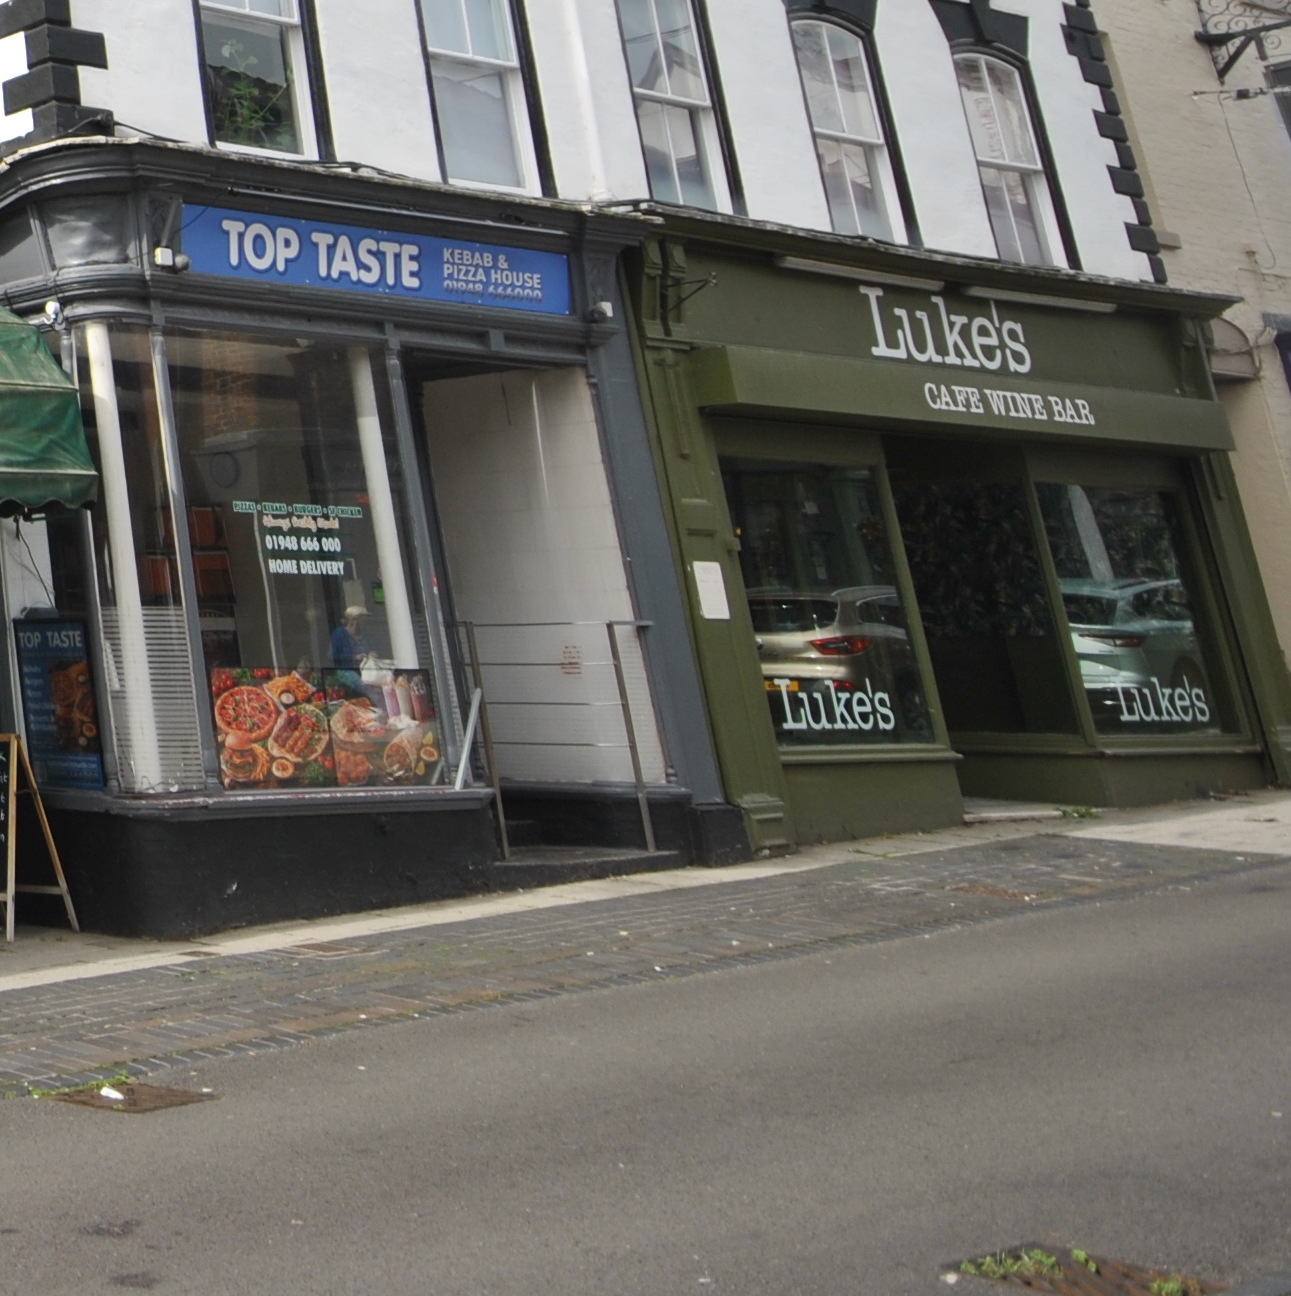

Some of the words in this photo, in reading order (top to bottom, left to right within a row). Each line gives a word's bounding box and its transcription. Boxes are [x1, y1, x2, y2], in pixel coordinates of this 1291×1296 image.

[222, 219, 300, 273] TOP
[311, 231, 420, 289] TASTE
[442, 247, 495, 268] KEBAB
[497, 255, 509, 269] &
[442, 266, 488, 284] PIZZA
[490, 268, 542, 289] HOUSE
[858, 285, 1032, 374] Luke's
[923, 382, 985, 414] CAFE
[983, 388, 1048, 421] WINE
[1047, 395, 1096, 426] BAR
[265, 534, 299, 551] 01948
[299, 536, 320, 552] 666
[321, 537, 342, 552] 000
[268, 558, 299, 575] HOME
[299, 559, 345, 575] DELIVERY
[18, 631, 42, 649] TOP
[46, 630, 83, 648] TASTE
[773, 677, 896, 731] Luke's
[1114, 674, 1210, 723] Luke's
